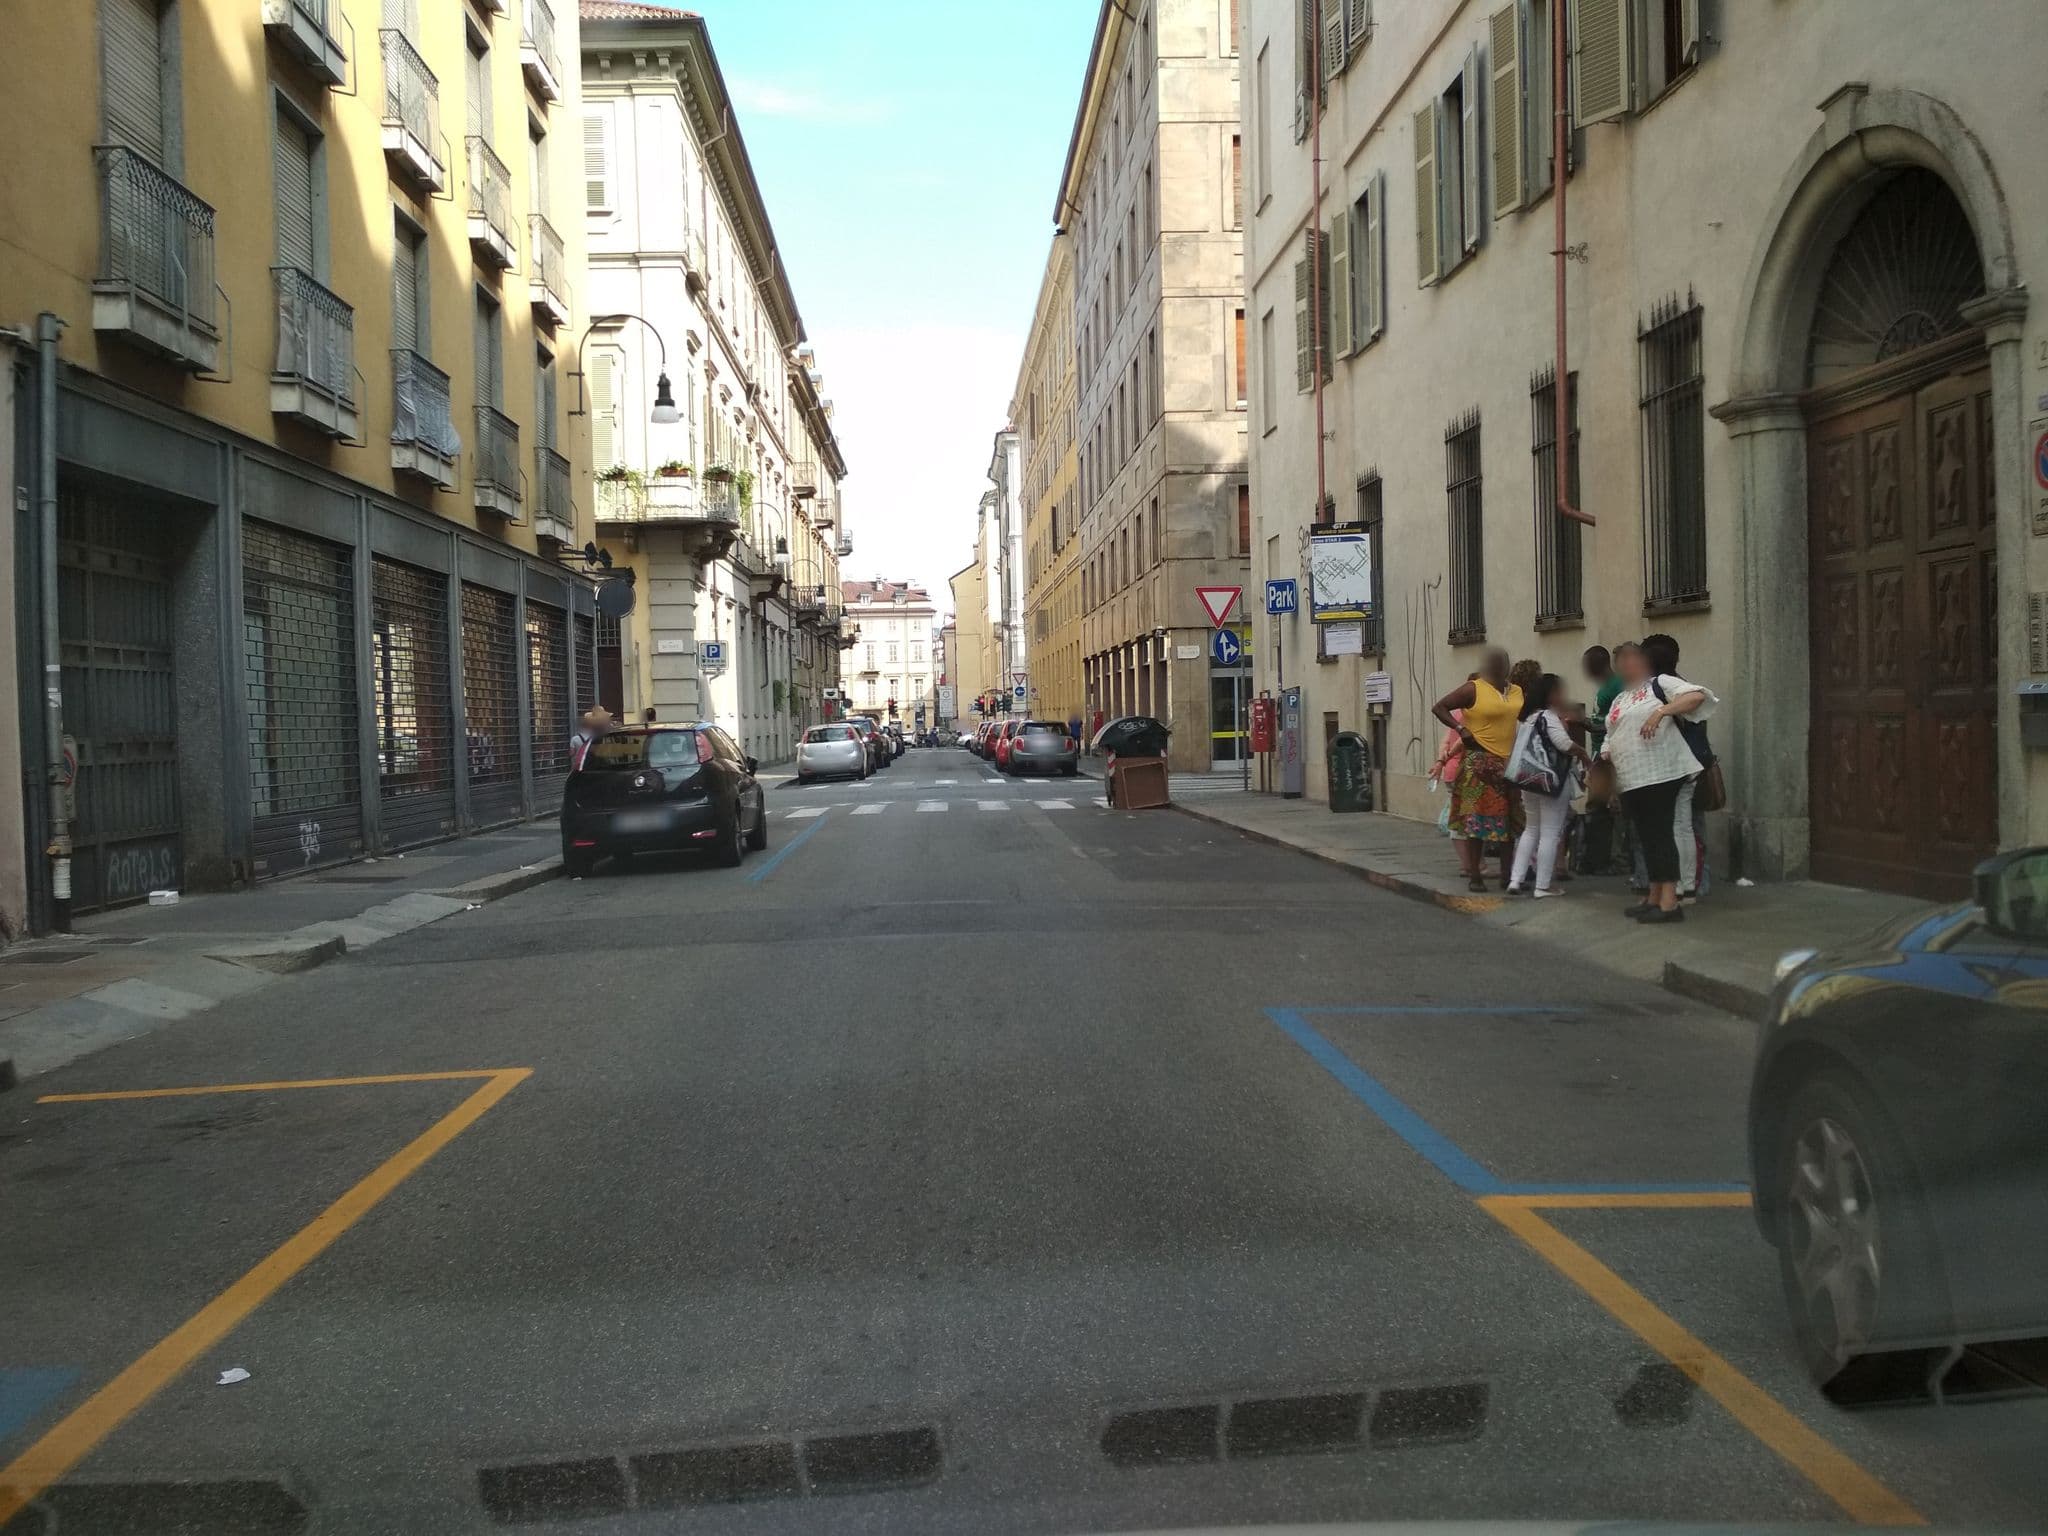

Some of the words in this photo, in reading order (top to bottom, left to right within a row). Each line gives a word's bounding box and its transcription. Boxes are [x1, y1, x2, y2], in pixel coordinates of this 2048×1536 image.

[1269, 585, 1293, 608] Park
[709, 645, 719, 657] P
[1289, 694, 1297, 707] P
